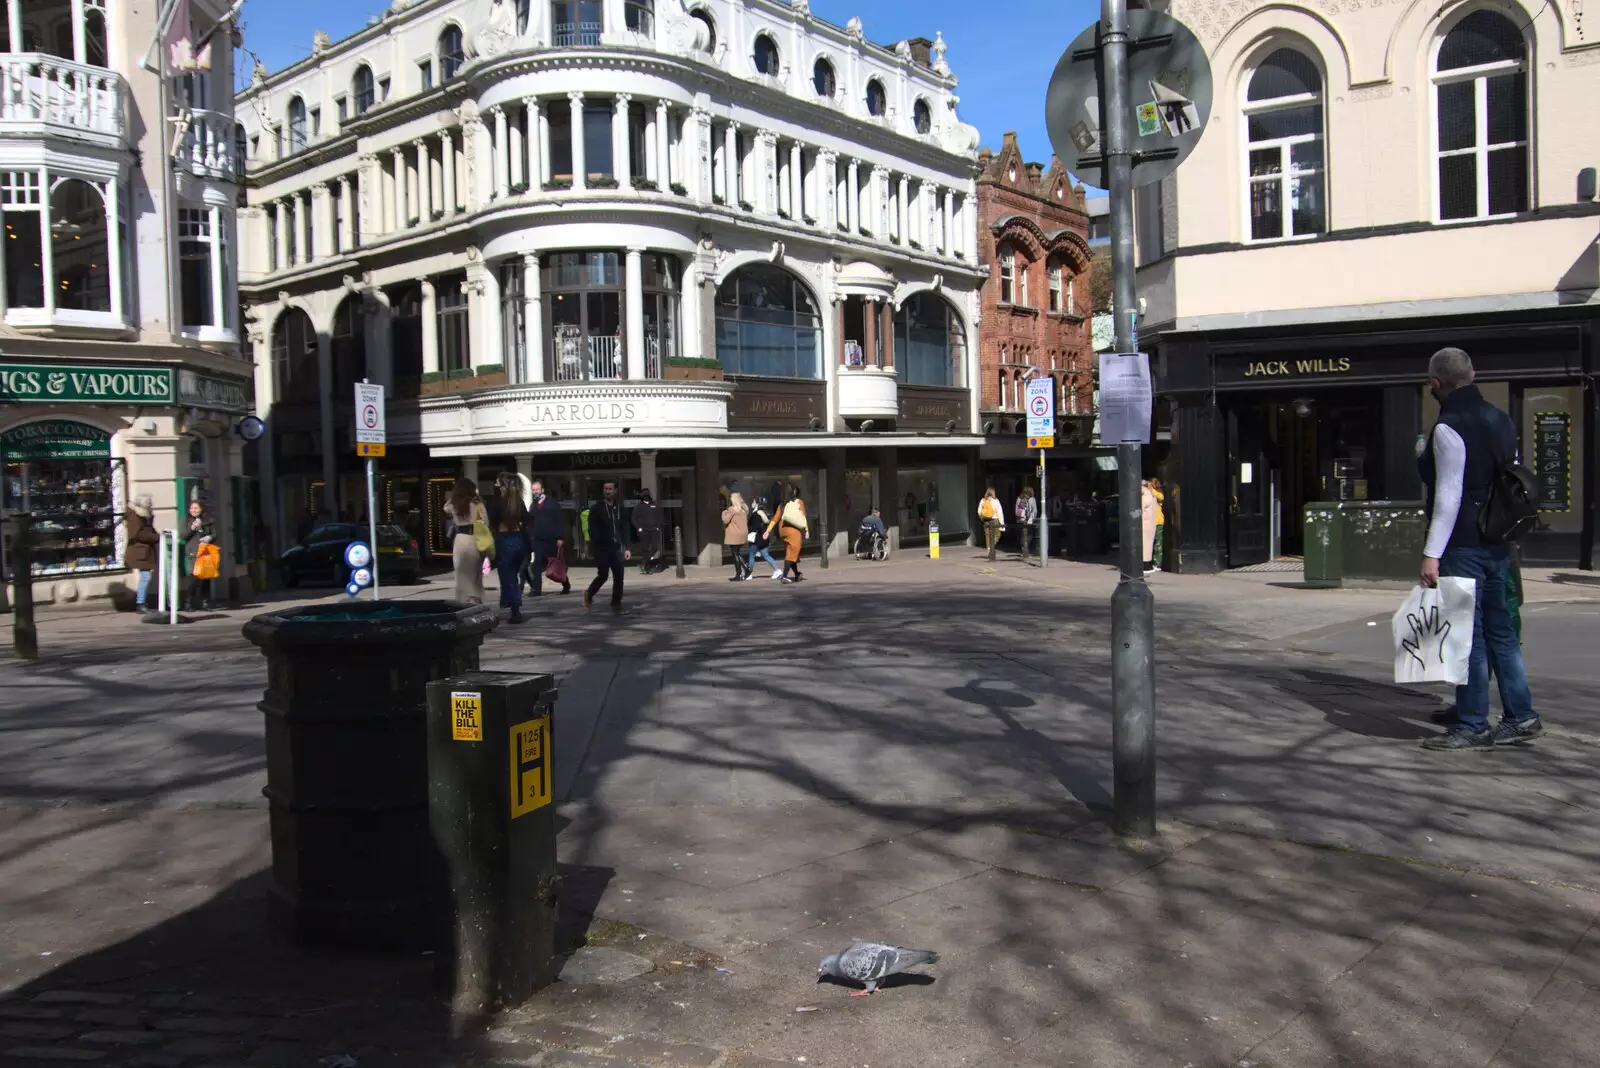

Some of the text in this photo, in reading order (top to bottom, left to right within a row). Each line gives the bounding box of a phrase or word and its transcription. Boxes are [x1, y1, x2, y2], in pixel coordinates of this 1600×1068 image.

[1244, 357, 1351, 376] JACK WILLS
[46, 372, 68, 395] &
[70, 372, 169, 396] VAPOURS
[362, 395, 377, 403] ZONE
[530, 403, 635, 422] JARROLDS
[6, 423, 108, 443] TOBACCONIST
[569, 453, 627, 466] JARROLD
[455, 700, 478, 709] KILL
[455, 709, 474, 718] THE
[456, 718, 478, 728] BILL
[523, 728, 539, 744] 125
[525, 746, 537, 758] FIRE
[529, 784, 536, 798] 3
